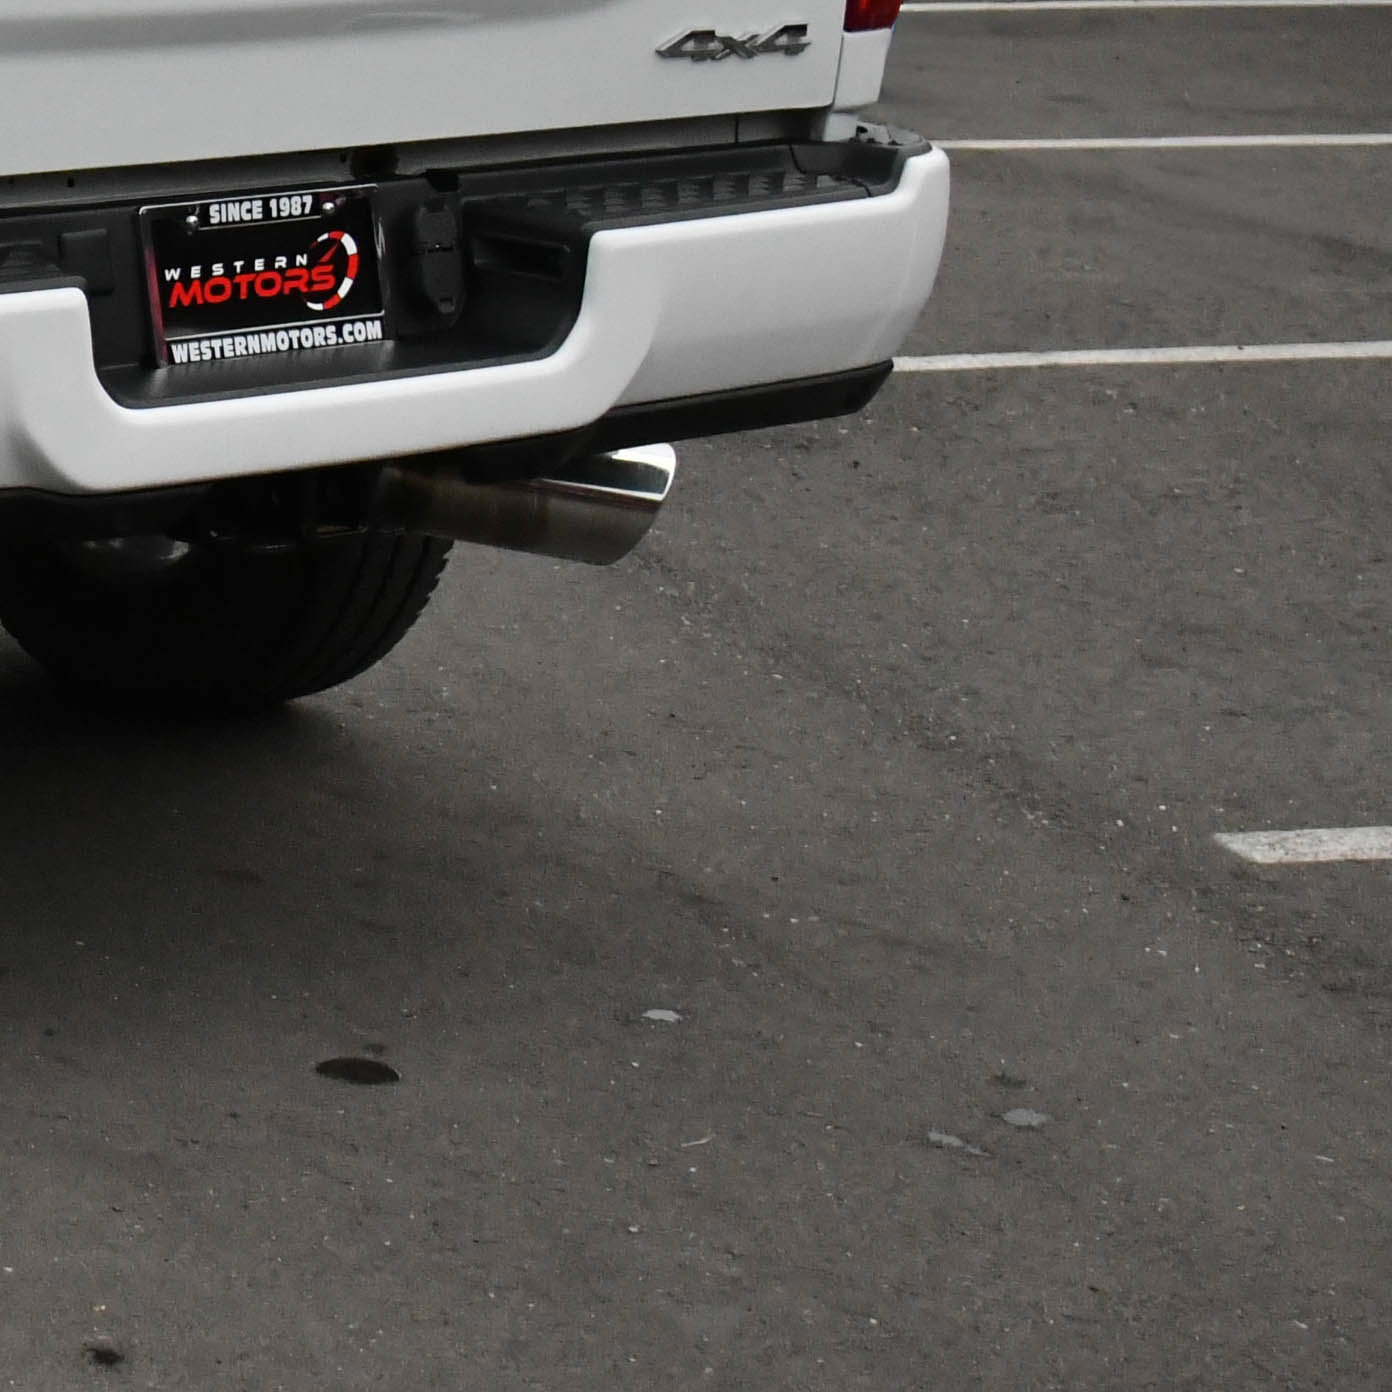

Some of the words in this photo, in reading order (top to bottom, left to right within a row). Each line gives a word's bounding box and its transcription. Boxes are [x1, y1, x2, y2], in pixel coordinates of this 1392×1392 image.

[208, 199, 264, 224] SINCE
[269, 194, 313, 218] 1987
[164, 253, 308, 281] WESTERN
[169, 264, 337, 308] MOTORS
[170, 319, 383, 364] WESTERNMOTORS.COM
